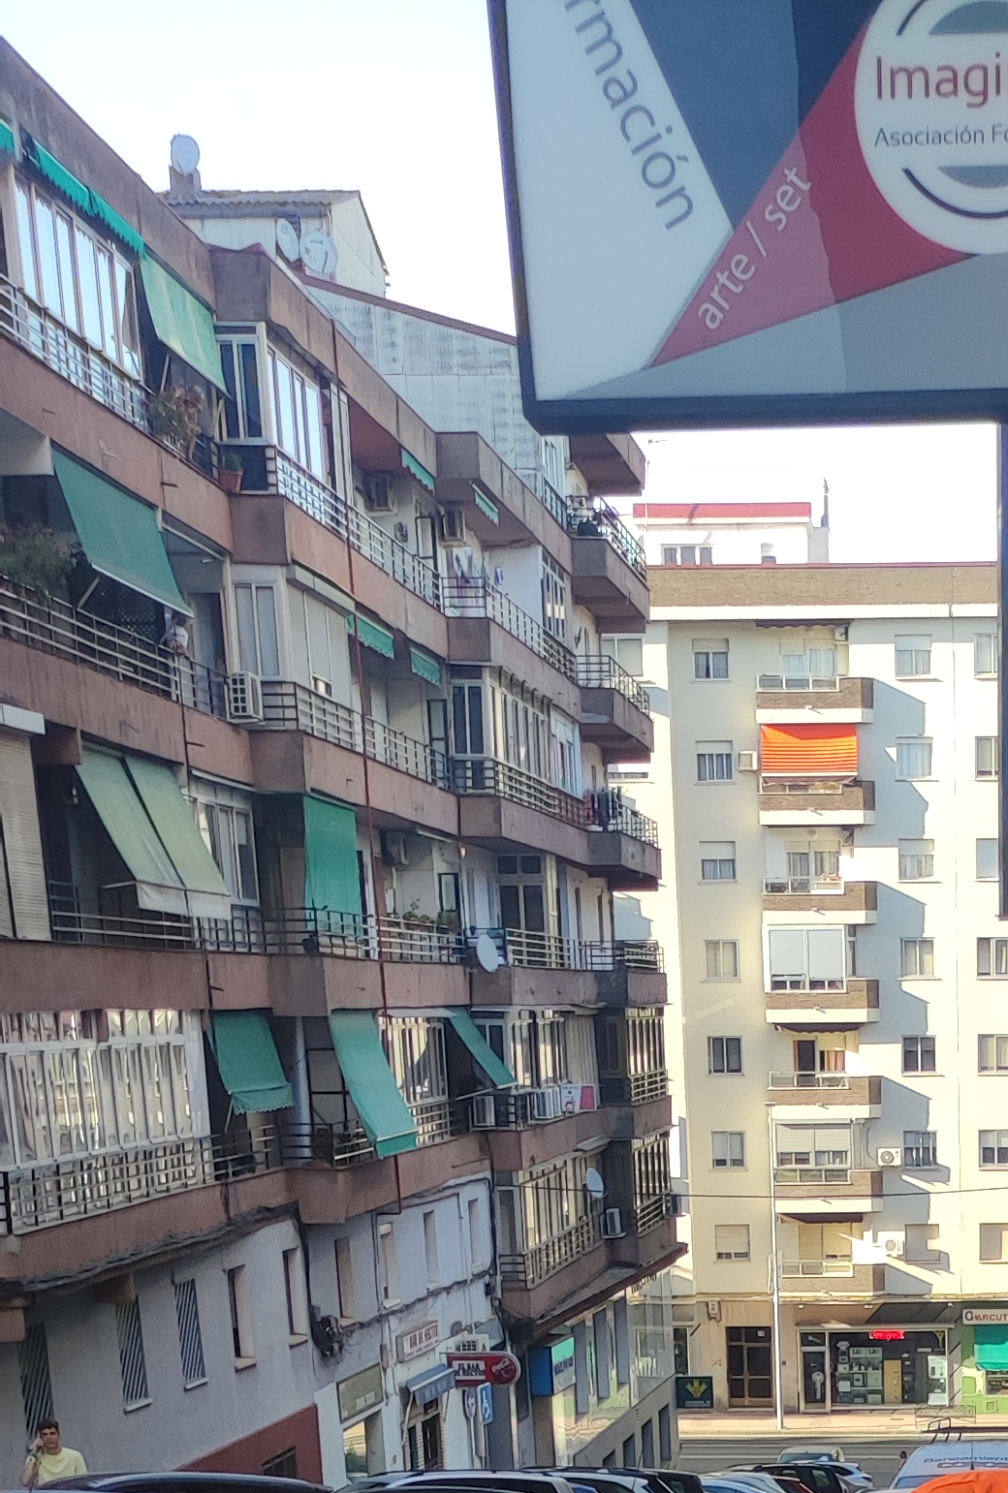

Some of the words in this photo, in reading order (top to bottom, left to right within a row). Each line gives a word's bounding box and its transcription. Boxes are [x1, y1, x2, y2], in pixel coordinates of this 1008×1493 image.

[874, 127, 985, 147] Asociación
[698, 253, 756, 330] arte
[764, 167, 812, 232] set
